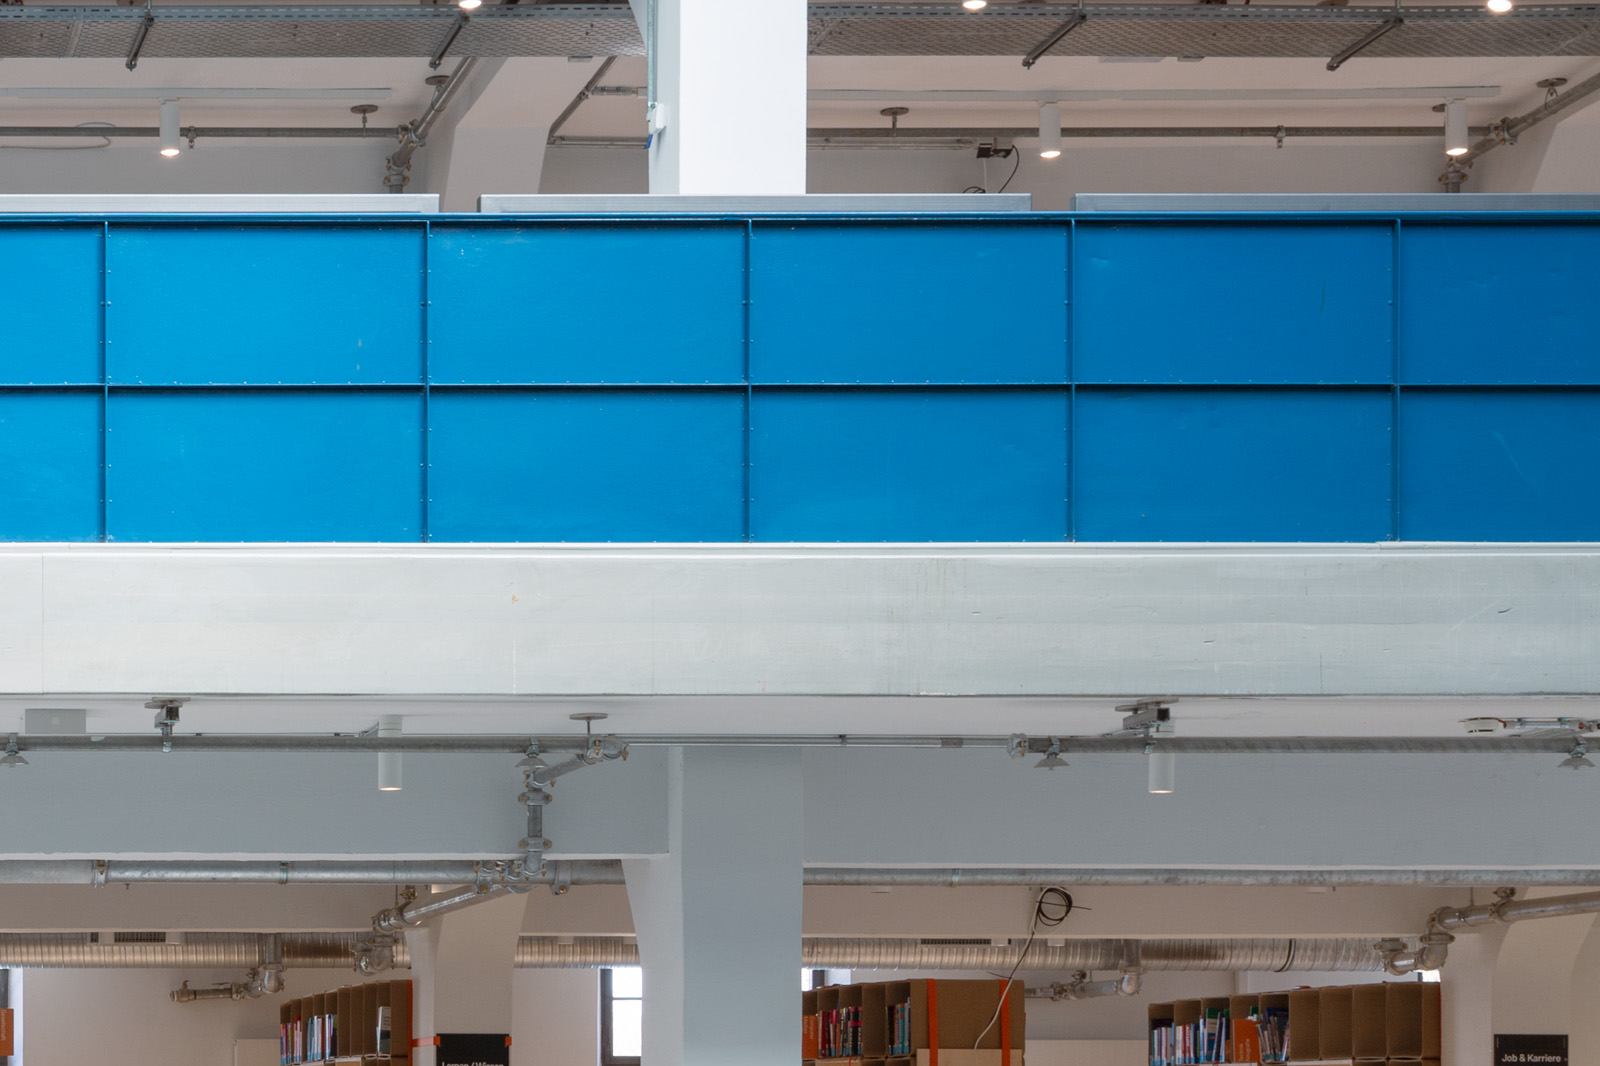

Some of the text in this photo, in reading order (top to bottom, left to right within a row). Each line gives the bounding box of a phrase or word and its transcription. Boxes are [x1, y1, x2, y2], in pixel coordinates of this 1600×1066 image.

[1502, 1053, 1562, 1062] Job & Karriere
